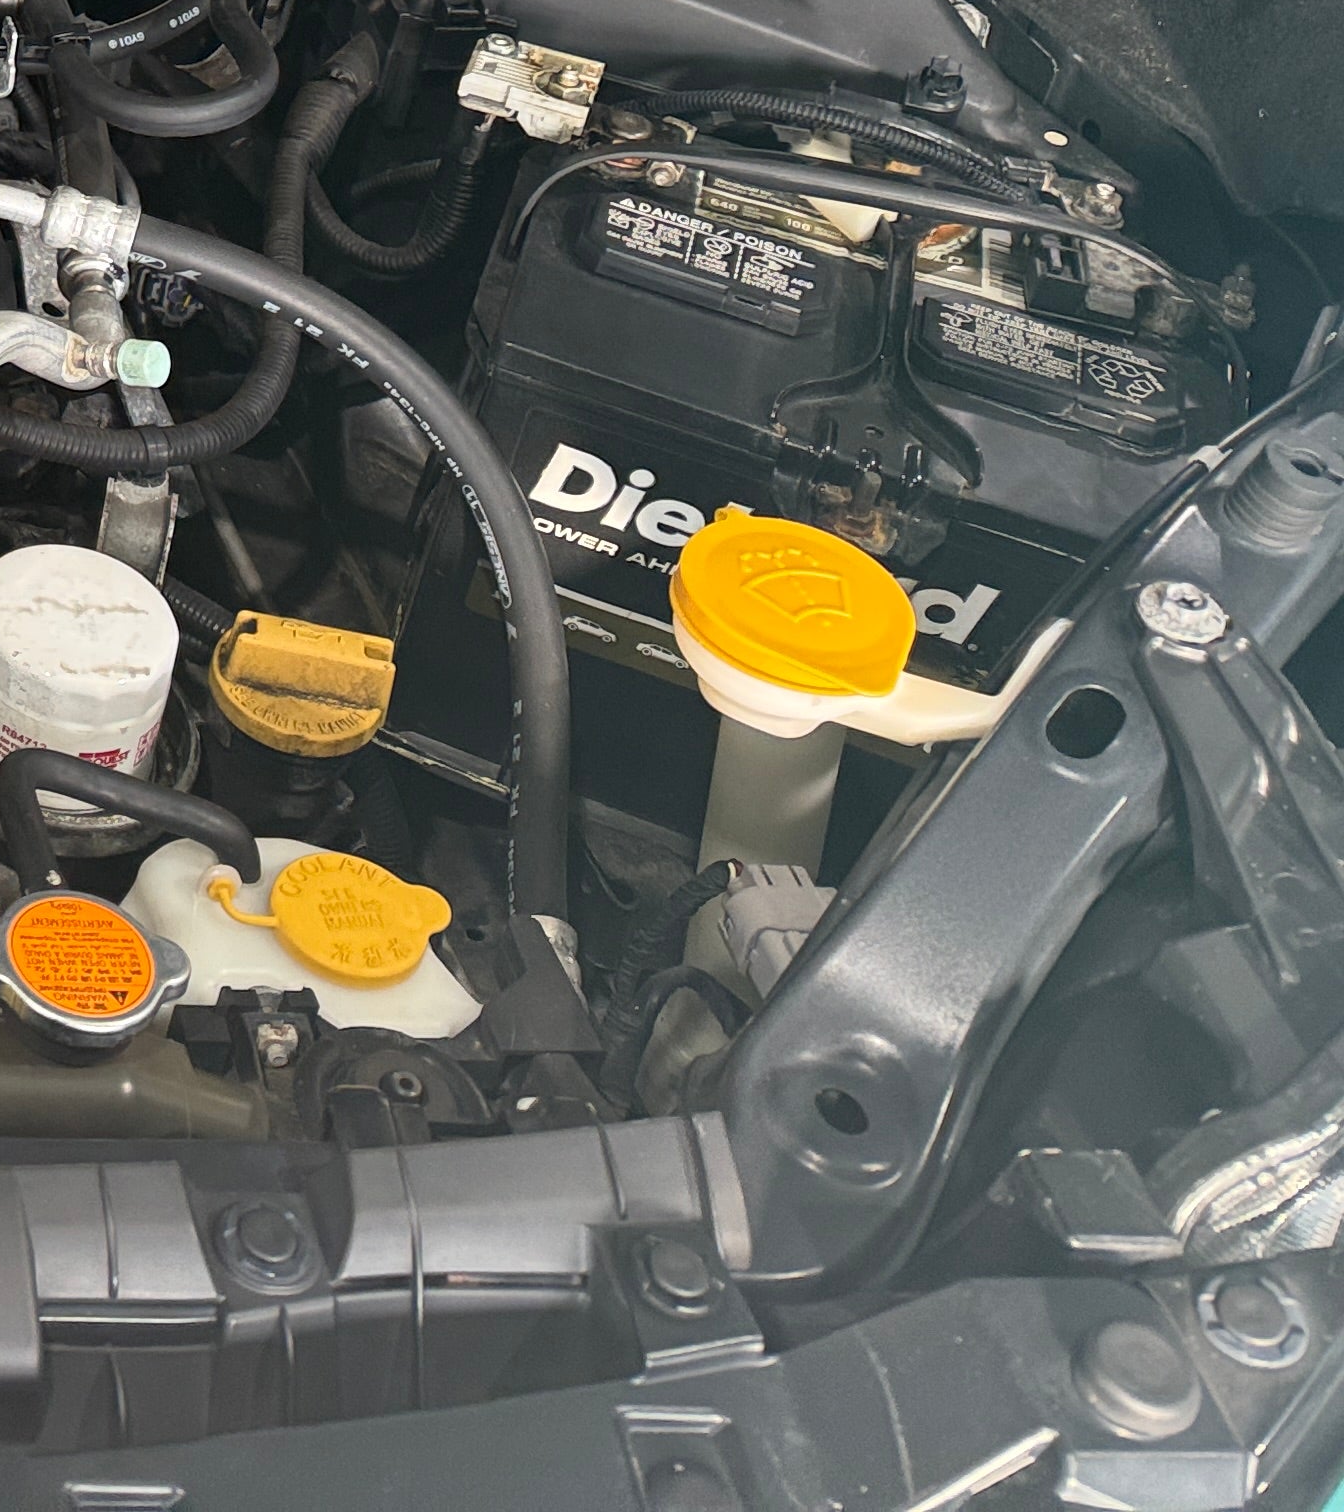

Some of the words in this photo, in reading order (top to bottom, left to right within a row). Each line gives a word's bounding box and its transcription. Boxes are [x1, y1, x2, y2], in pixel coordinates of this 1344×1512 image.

[710, 197, 739, 213] 640
[638, 201, 714, 234] DANGER
[733, 232, 804, 260] POISON
[786, 217, 812, 233] 100
[532, 517, 620, 557] OWER
[278, 856, 397, 898] COOLANT
[30, 917, 114, 929] AVERTISSEMENT
[54, 991, 109, 1003] WARNING
